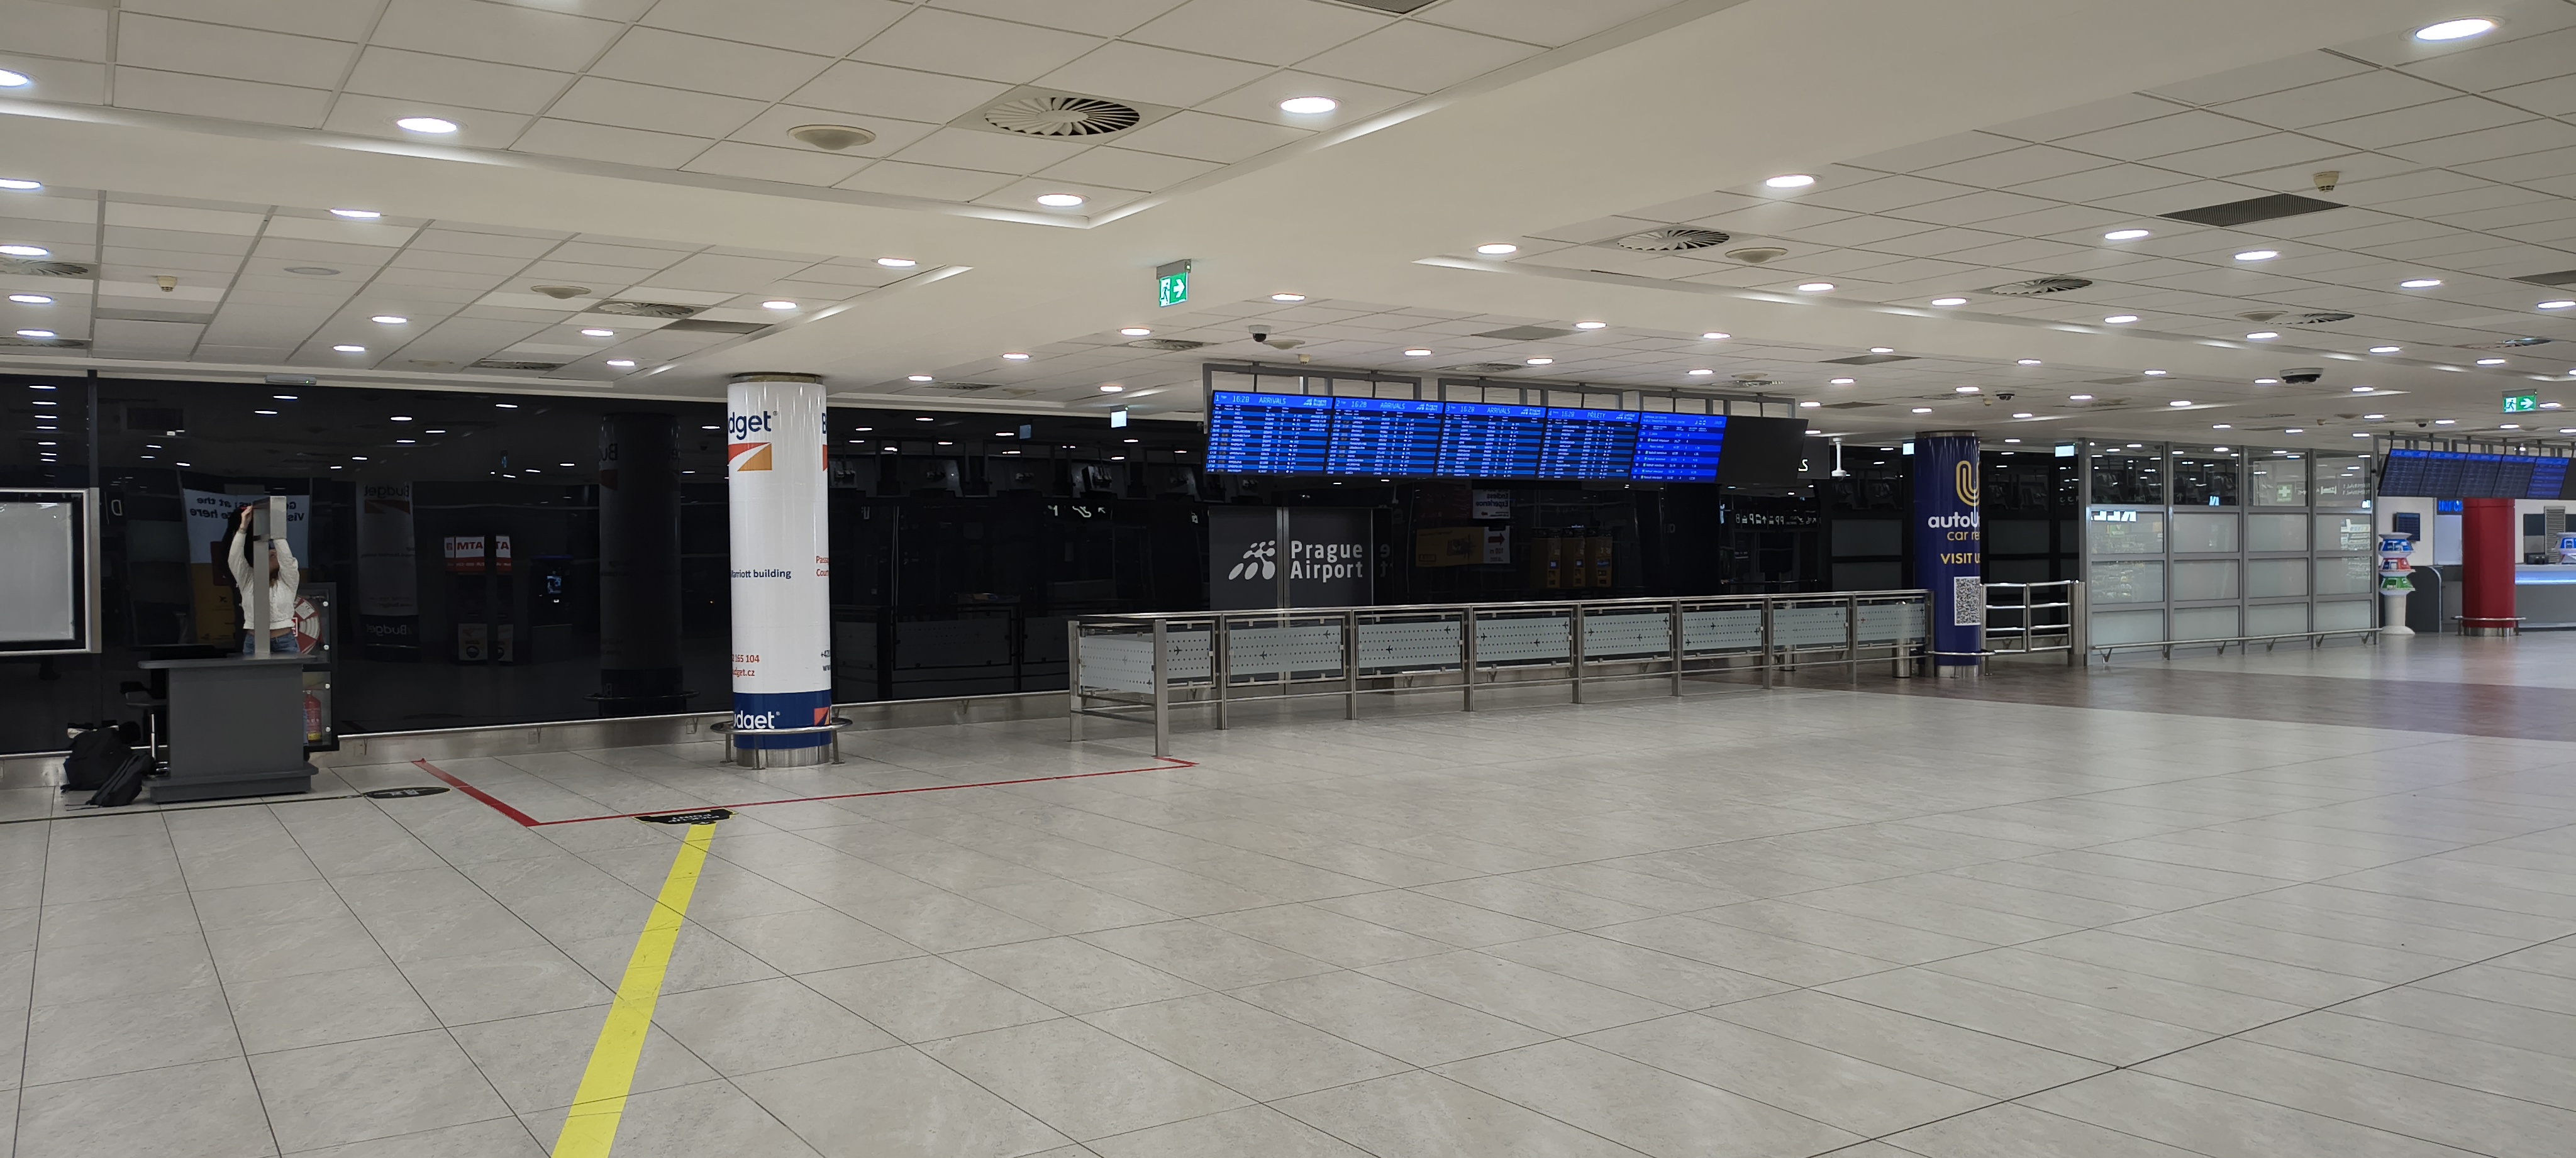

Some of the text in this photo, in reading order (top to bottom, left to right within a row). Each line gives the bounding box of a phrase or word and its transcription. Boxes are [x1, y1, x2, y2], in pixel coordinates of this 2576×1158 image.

[1946, 531, 1968, 541] car
[1291, 540, 1363, 563] Prague
[1940, 553, 1973, 565] VISIT
[753, 568, 792, 579] building
[1290, 560, 1363, 583] Airport
[746, 654, 760, 663] 104
